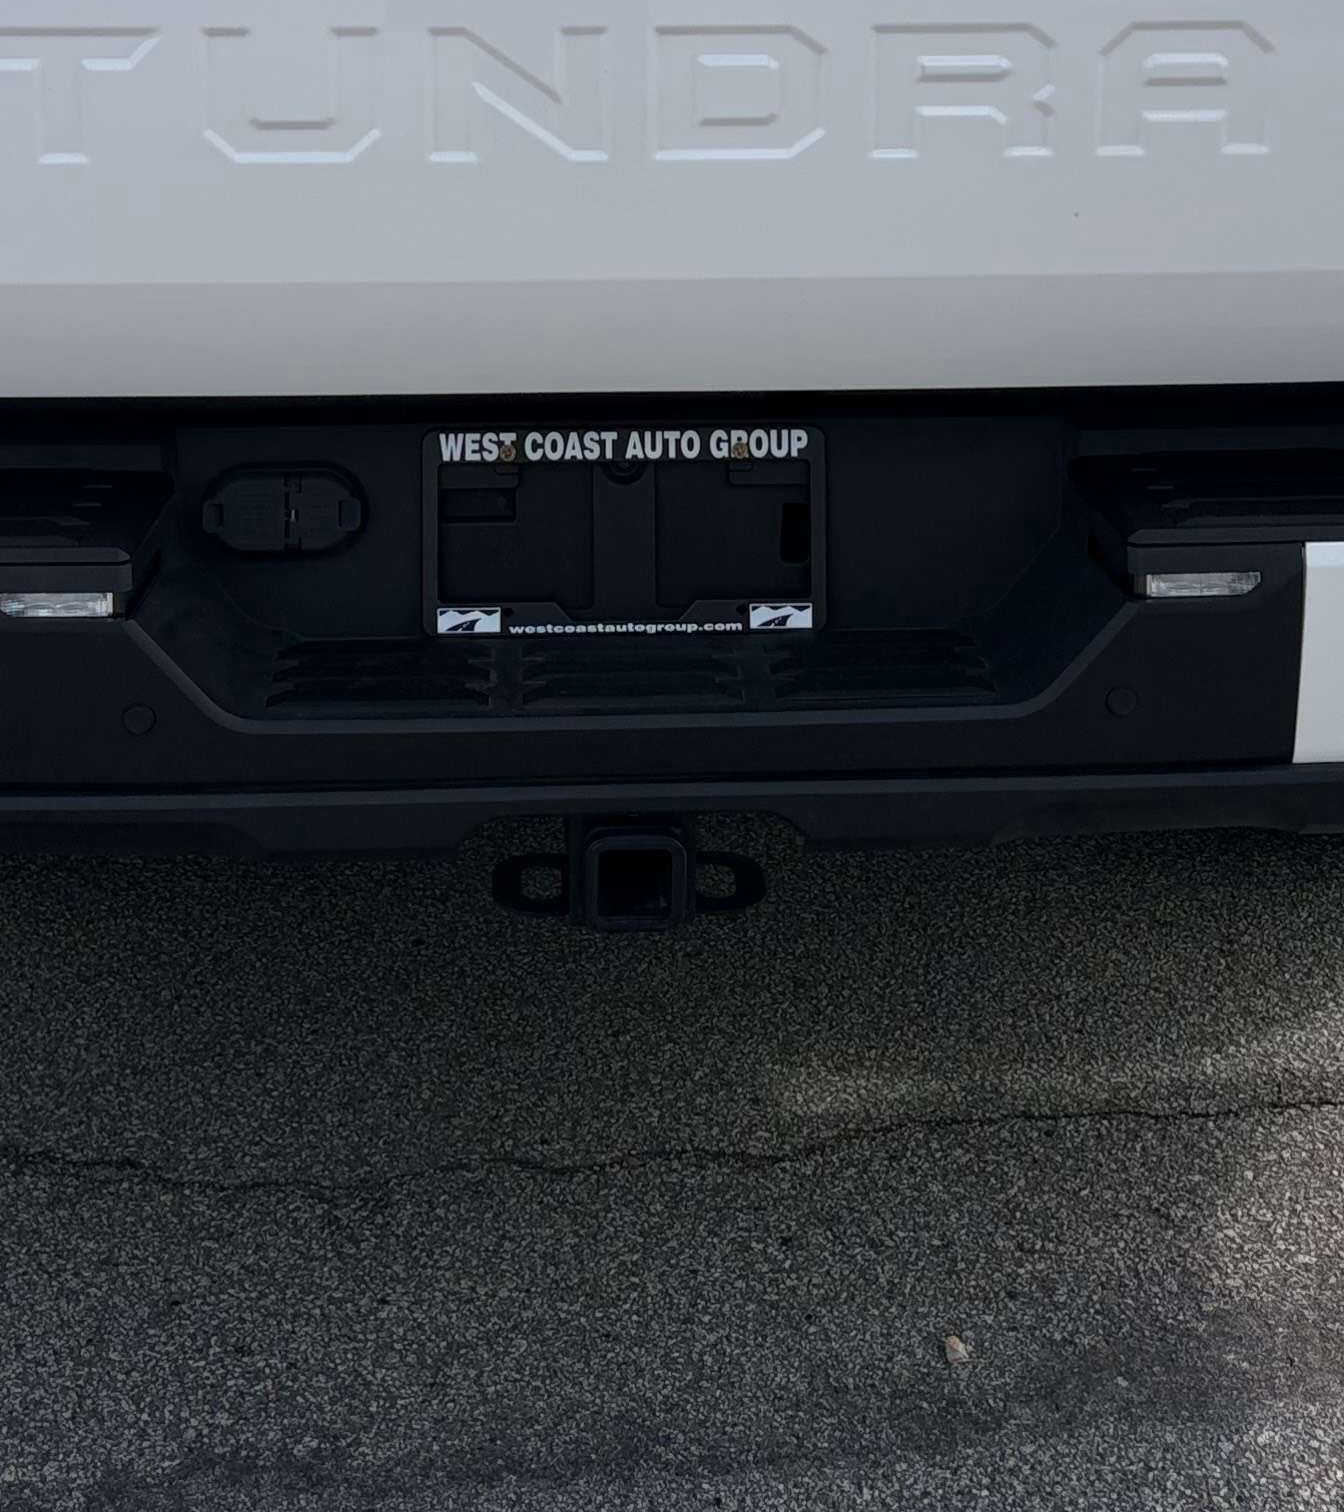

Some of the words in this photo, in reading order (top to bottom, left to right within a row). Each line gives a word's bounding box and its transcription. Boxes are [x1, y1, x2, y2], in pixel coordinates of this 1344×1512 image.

[439, 432, 517, 462] WEST
[524, 431, 618, 461] COAST
[625, 430, 701, 459] AUTO
[709, 429, 808, 459] GROUP
[508, 622, 743, 634] westcoastautogroup.com
